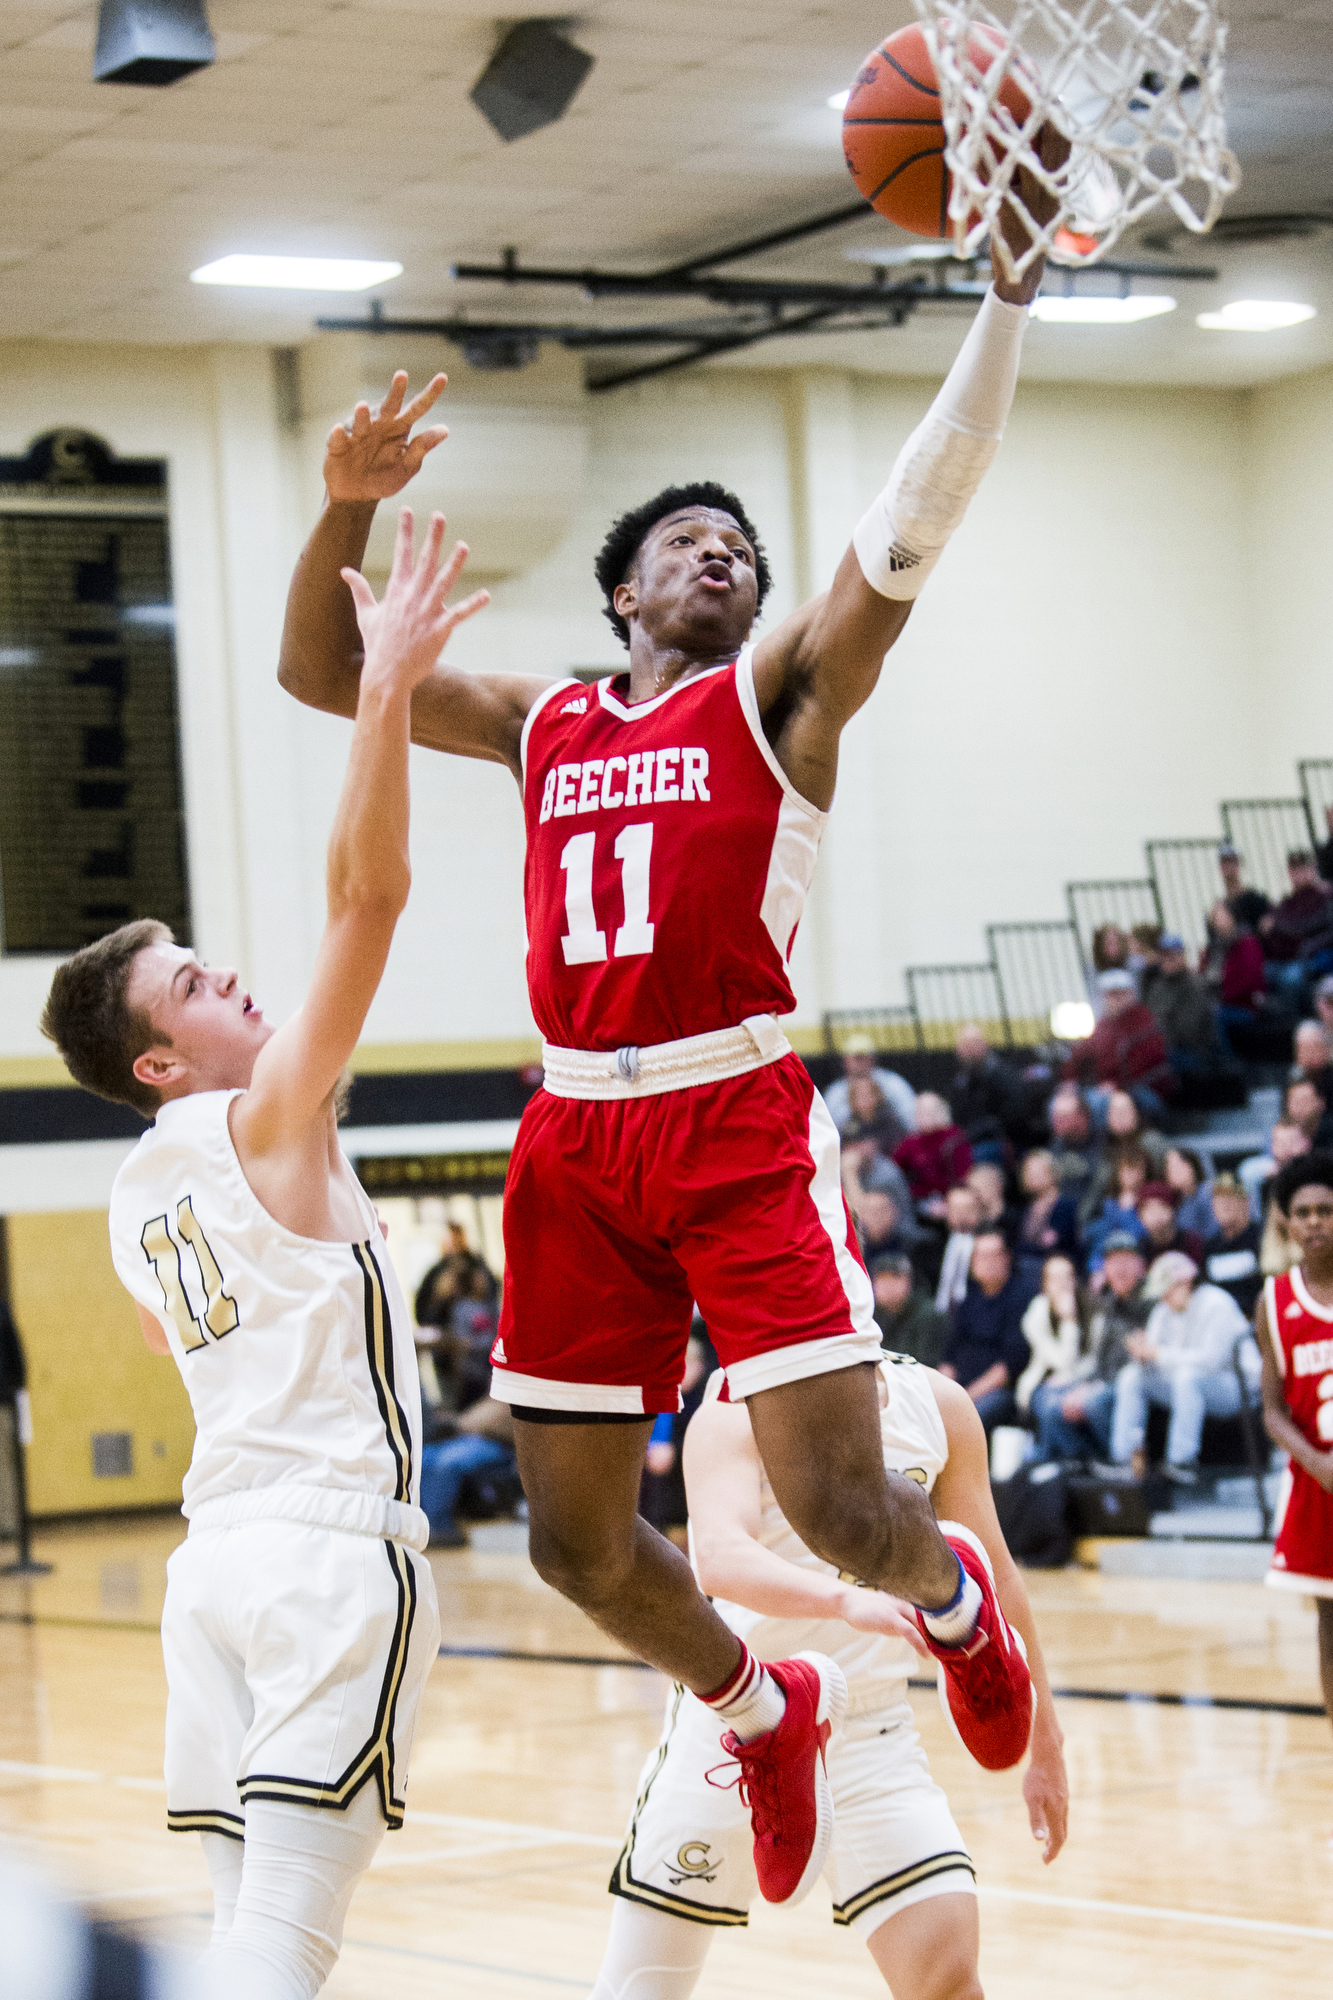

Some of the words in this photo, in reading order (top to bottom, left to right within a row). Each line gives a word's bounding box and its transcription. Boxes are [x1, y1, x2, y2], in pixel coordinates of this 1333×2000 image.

[539, 746, 711, 825] BEECHER
[559, 821, 655, 966] 11
[140, 1194, 241, 1355] 11
[677, 1840, 711, 1872] C
